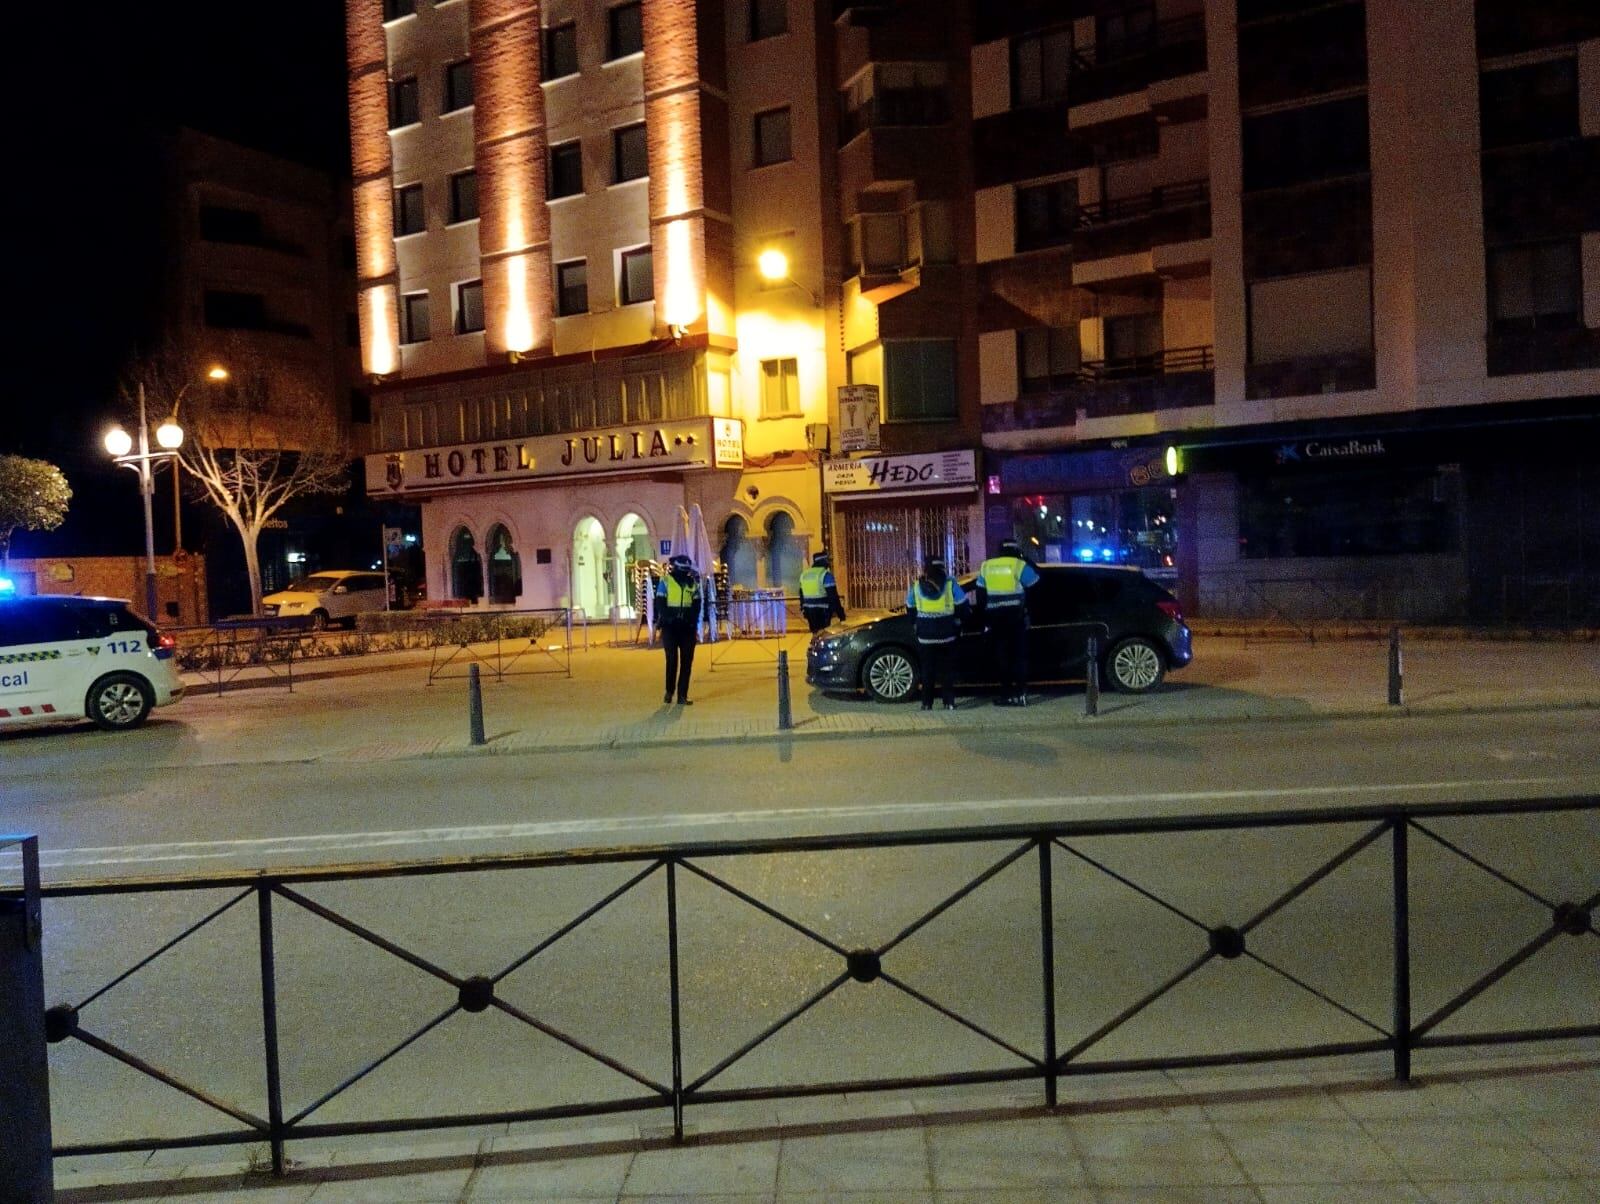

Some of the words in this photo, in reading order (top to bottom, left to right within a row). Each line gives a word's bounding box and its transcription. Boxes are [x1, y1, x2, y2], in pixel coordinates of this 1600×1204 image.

[716, 439, 741, 449] HOTEL
[1305, 438, 1386, 457] CaixaBank
[424, 443, 535, 479] HOTEL
[560, 429, 672, 467] JULIA
[719, 449, 740, 459] JULIA
[868, 459, 934, 486] HEDO
[107, 640, 142, 654] 112
